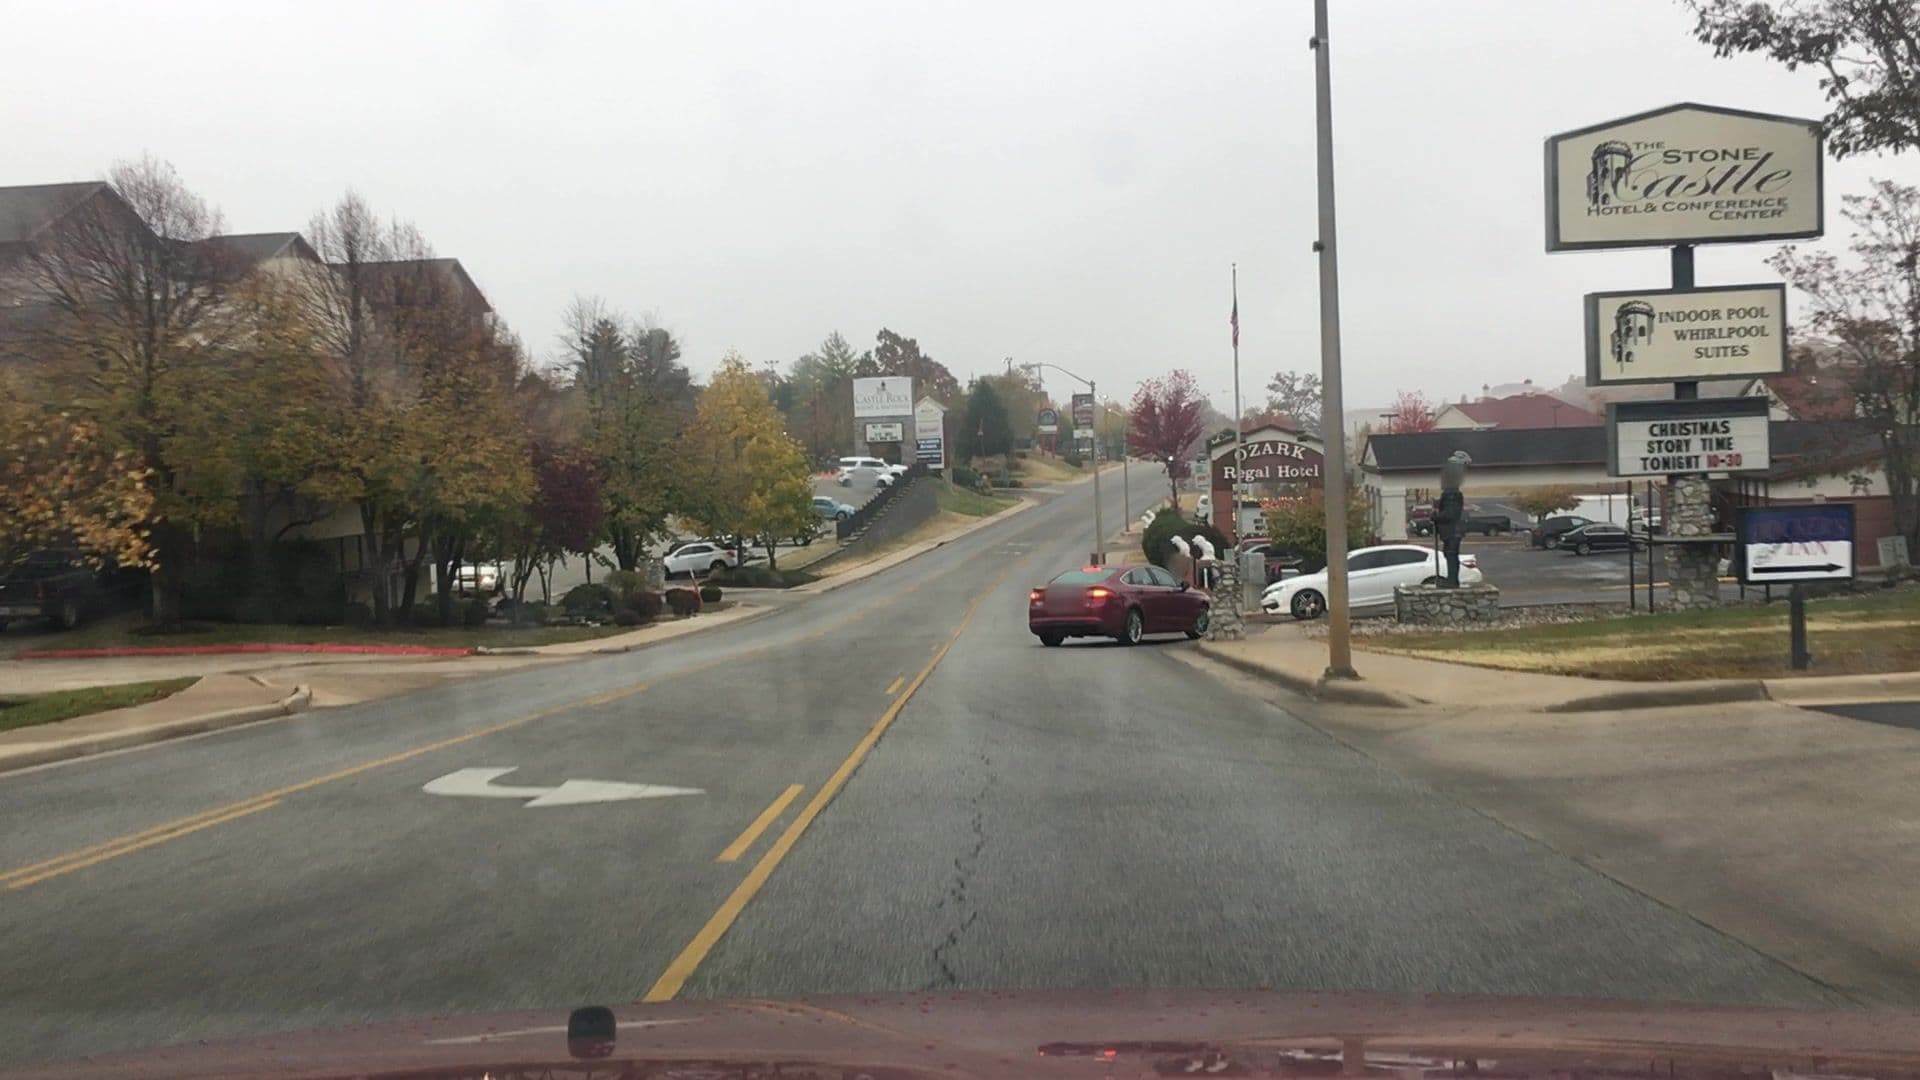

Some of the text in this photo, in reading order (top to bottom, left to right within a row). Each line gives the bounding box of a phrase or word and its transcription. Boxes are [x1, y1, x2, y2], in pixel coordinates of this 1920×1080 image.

[1633, 141, 1665, 149] THE
[1662, 147, 1760, 164] STONE
[1612, 150, 1793, 202] Castle
[1662, 197, 1788, 212] CONFERENCE
[1708, 209, 1784, 220] CENTER
[1658, 306, 1770, 323] INDOOR POOL
[1674, 325, 1769, 341] WHIRLPOOL
[1694, 344, 1750, 359] SUITES
[1649, 420, 1731, 437] CHRISTMAS
[1235, 442, 1306, 460] OZARK
[1647, 437, 1734, 454] STORY TIME
[1640, 455, 1700, 471] TONIGHT
[1224, 466, 1270, 482] Regal
[1278, 464, 1319, 478] Hotel
